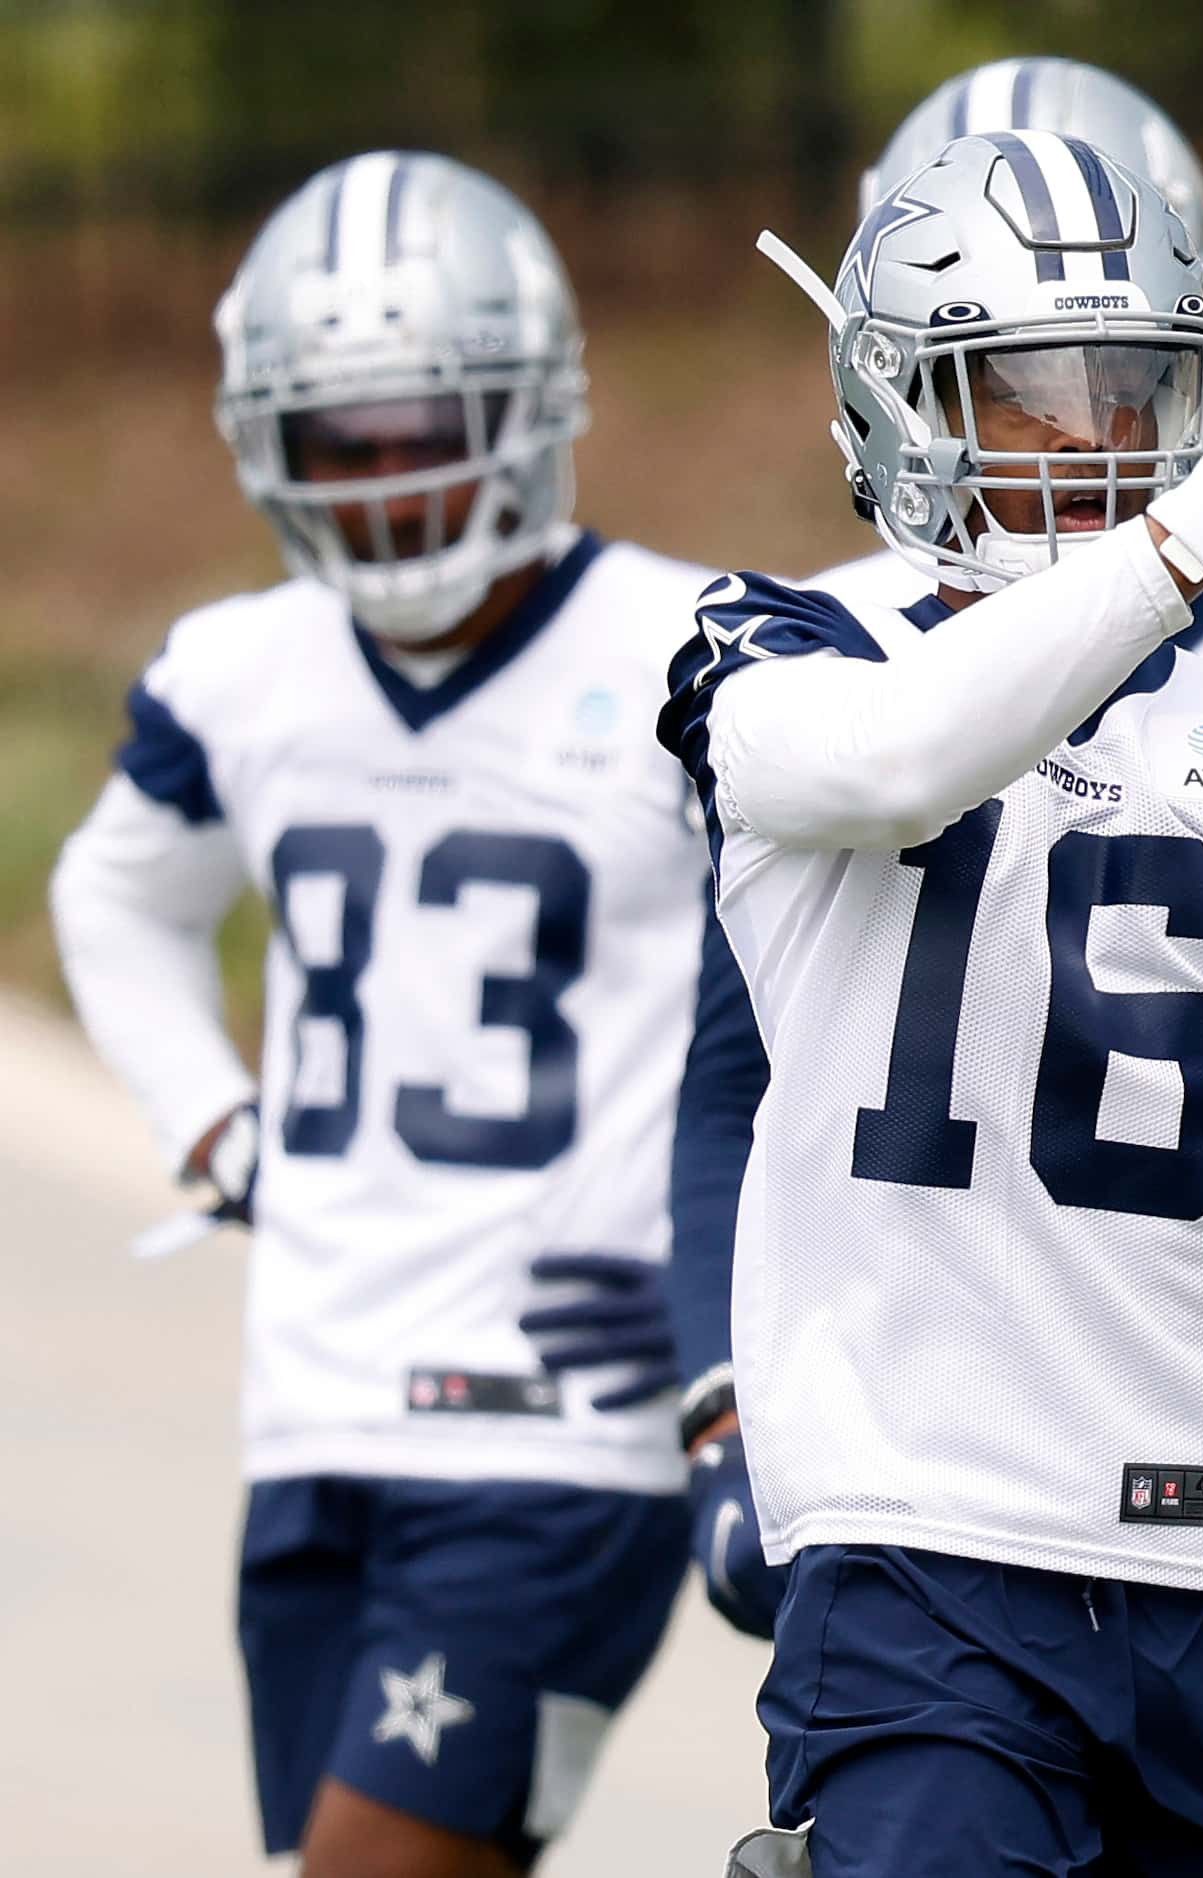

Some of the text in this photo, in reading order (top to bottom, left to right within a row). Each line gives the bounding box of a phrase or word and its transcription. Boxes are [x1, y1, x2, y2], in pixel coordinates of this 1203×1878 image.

[1055, 295, 1129, 311] COWBOYS
[1034, 757, 1123, 803] OWBOYS
[271, 825, 592, 1171] 83
